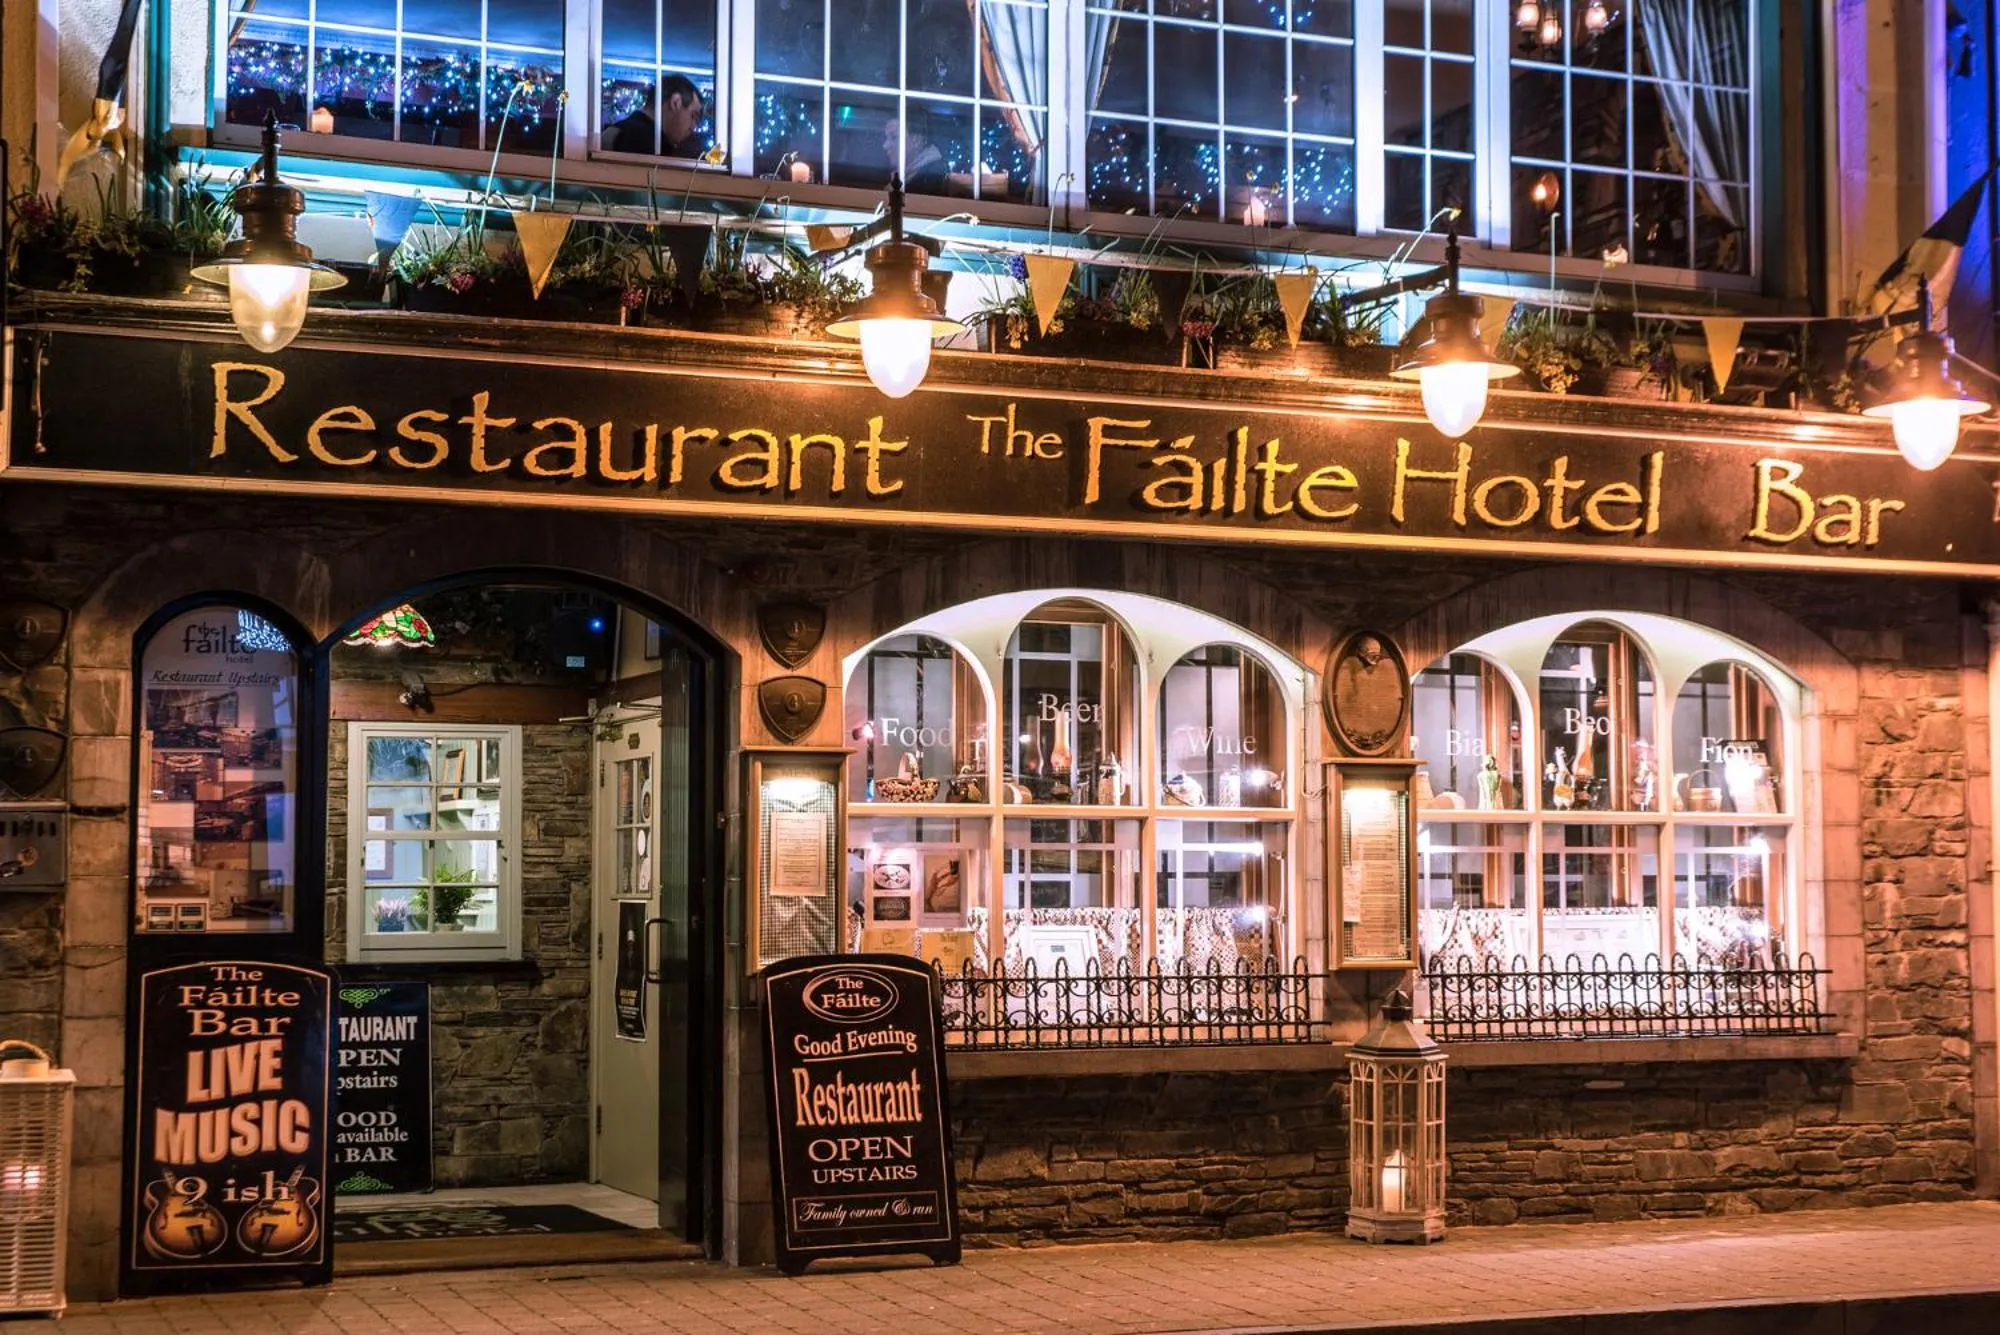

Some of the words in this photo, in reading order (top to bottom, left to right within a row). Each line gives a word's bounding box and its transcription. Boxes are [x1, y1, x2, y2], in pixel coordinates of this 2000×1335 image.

[210, 361, 910, 495] Restaurant
[965, 402, 1065, 460] The
[1084, 416, 1360, 519] Fáilte
[1391, 437, 1665, 534] Hotel
[1748, 457, 1907, 545] Bar
[152, 669, 224, 684] Restaurant
[1039, 691, 1104, 724] Beer
[1563, 707, 1611, 736] Beo
[880, 717, 955, 748] Food
[1186, 726, 1257, 757] Wine
[1444, 729, 1486, 757] Bia
[210, 966, 265, 982] The
[835, 976, 865, 990] The
[177, 985, 302, 1008] Fáilte
[821, 992, 882, 1010] Fáilte
[186, 1009, 292, 1037] Bar
[793, 1032, 844, 1056] Good
[845, 1023, 918, 1053] Evening
[187, 1037, 284, 1105] LIVE
[791, 1067, 924, 1127] Restaurant
[154, 1099, 311, 1166] MUSIC
[336, 1127, 409, 1144] available
[344, 1146, 399, 1163] BAR
[807, 1135, 914, 1163] OPEN
[174, 1176, 209, 1206] 9
[222, 1170, 297, 1203] ish
[812, 1164, 919, 1185] UPSTAIRS
[799, 1202, 847, 1227] Family
[849, 1201, 890, 1219] owned
